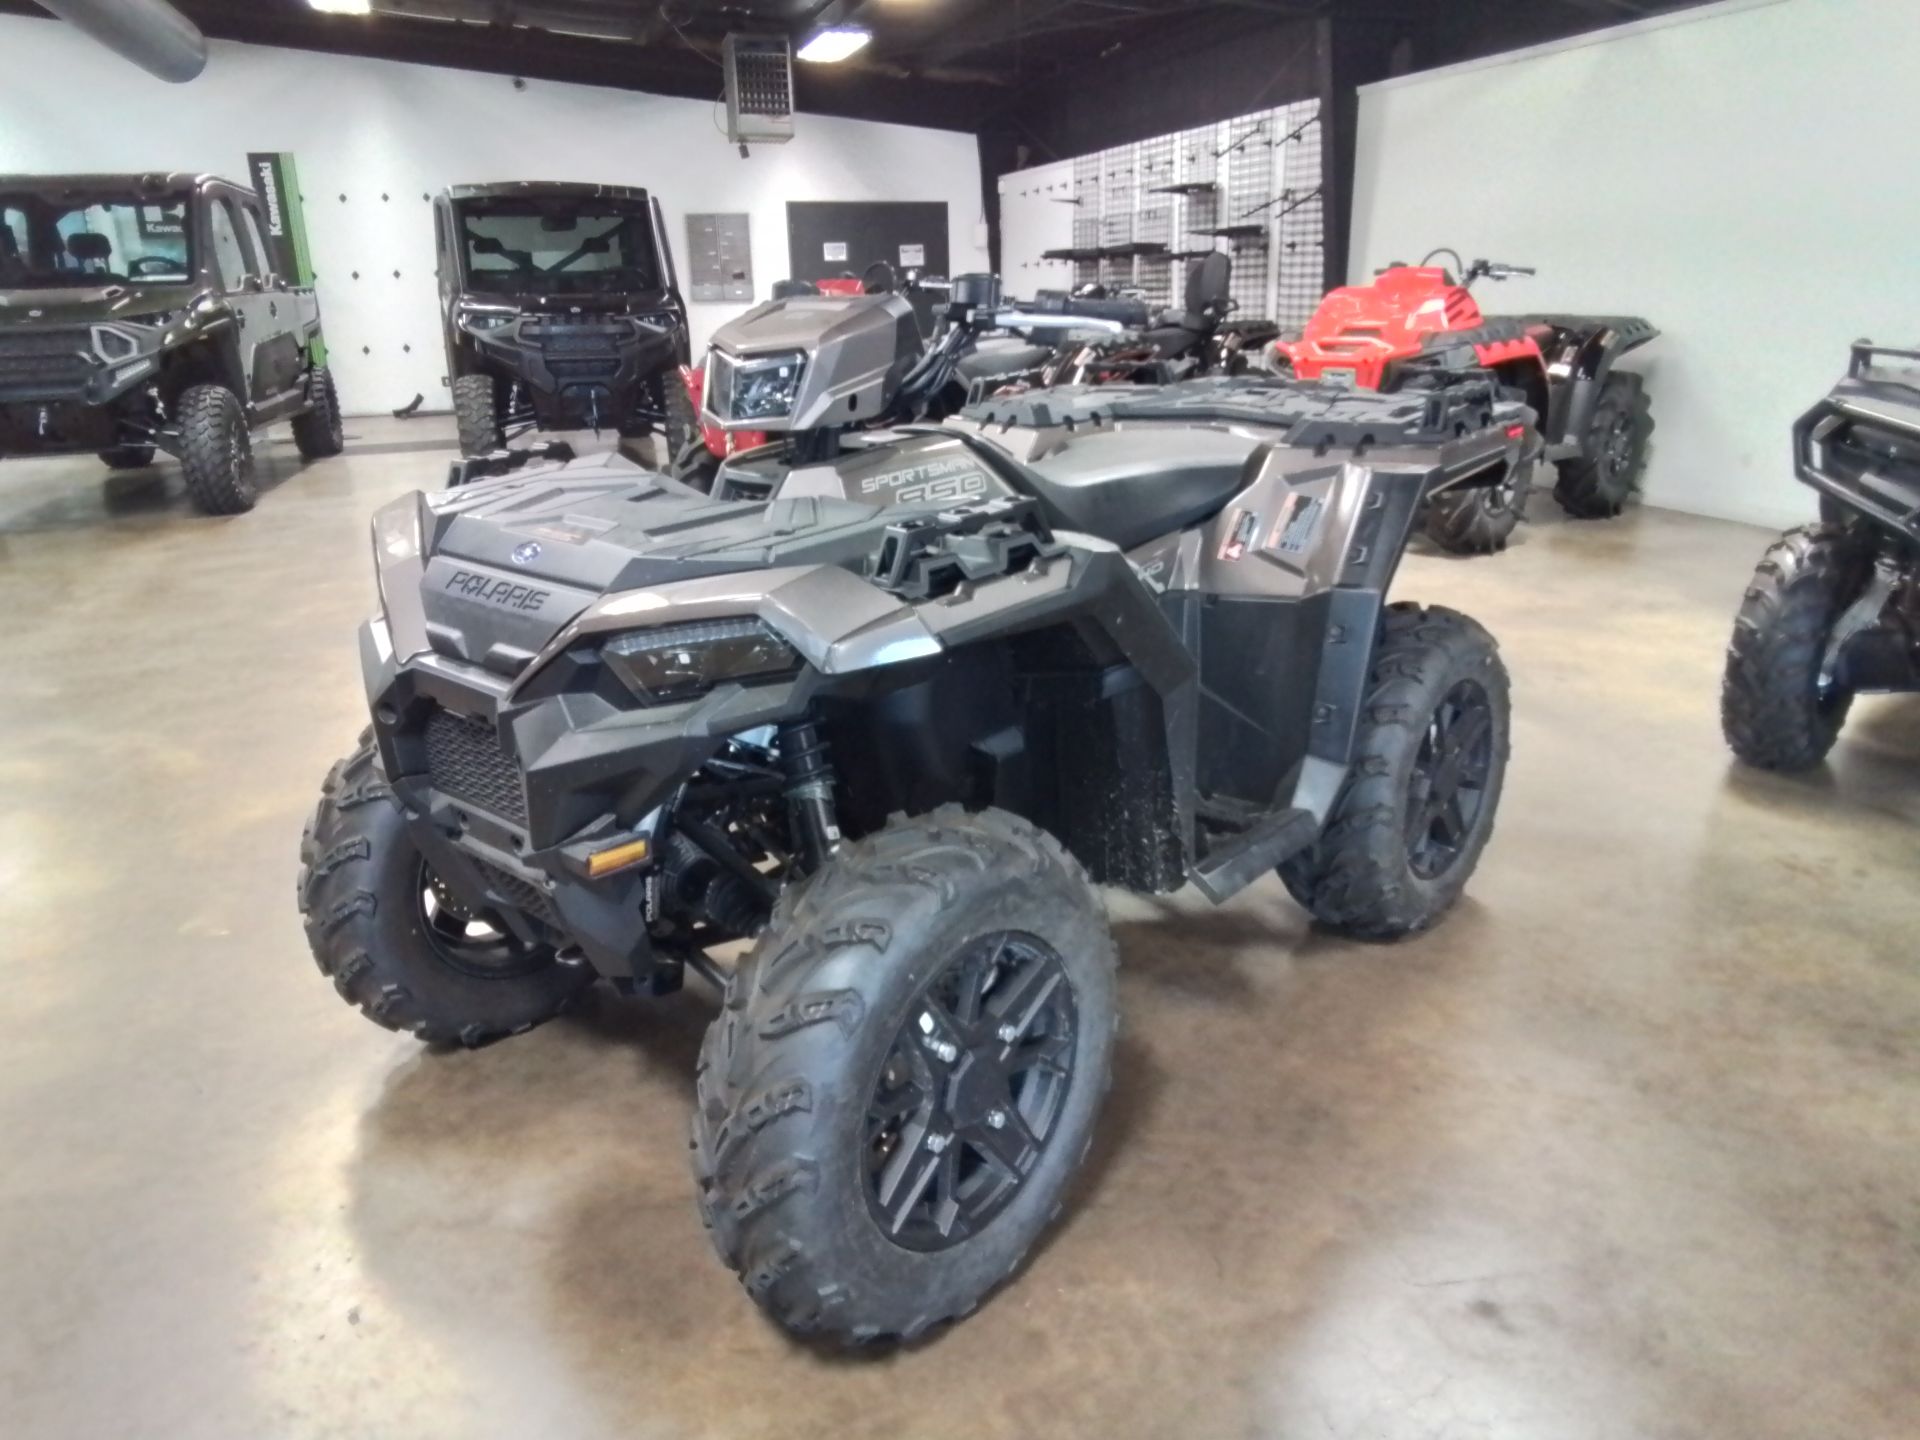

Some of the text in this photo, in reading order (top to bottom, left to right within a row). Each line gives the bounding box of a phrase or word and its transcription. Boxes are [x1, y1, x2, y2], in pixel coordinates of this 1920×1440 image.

[259, 162, 283, 236] Kawasaki
[146, 223, 184, 233] Kawa
[861, 460, 978, 494] SPORTSMAN
[445, 570, 551, 611] POLARIS
